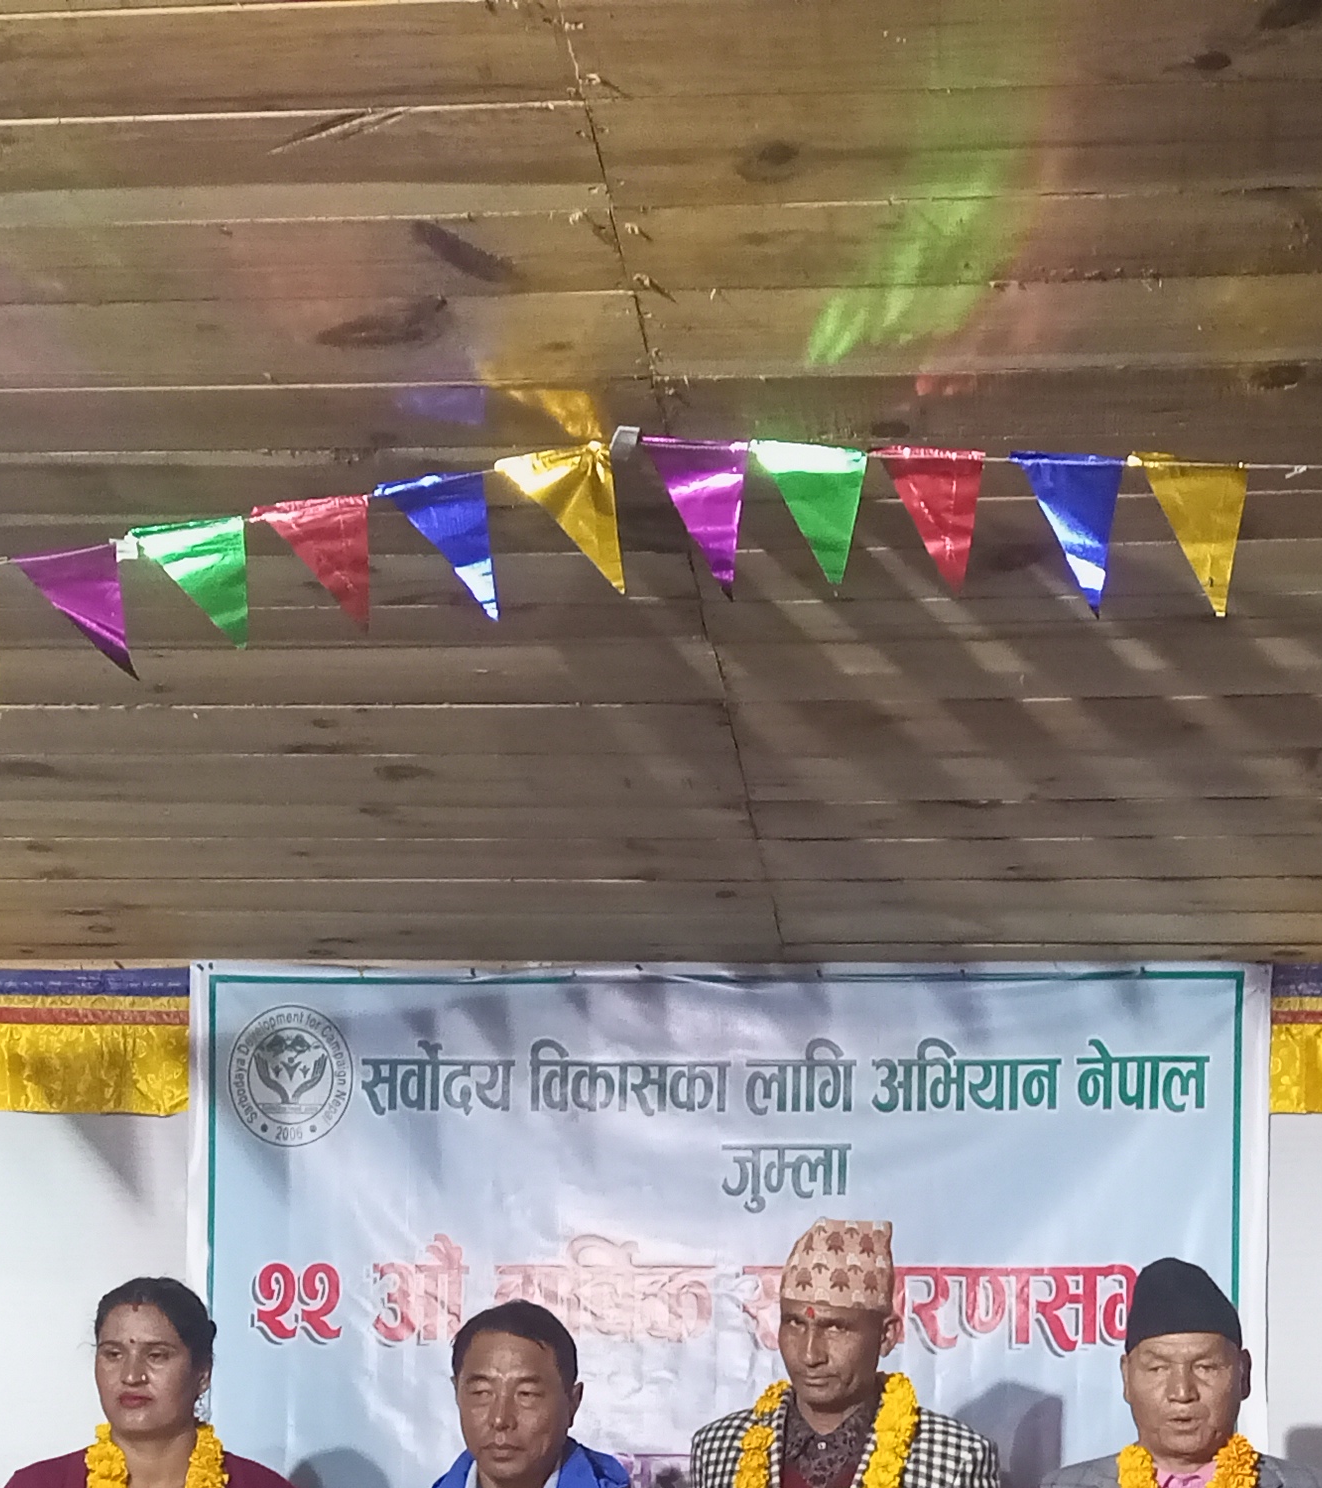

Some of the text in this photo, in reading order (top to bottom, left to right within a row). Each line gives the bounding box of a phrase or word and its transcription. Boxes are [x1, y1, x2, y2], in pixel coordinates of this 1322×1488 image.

[233, 1012, 347, 1126] Sarbodaya Development for Campaign Nepal
[360, 1038, 1211, 1116] सर्वोदय विकासका लागि अभियान नेपाल
[275, 1126, 303, 1141] 2006
[721, 1143, 852, 1214] जुम्ला
[252, 1262, 342, 1343] २२
